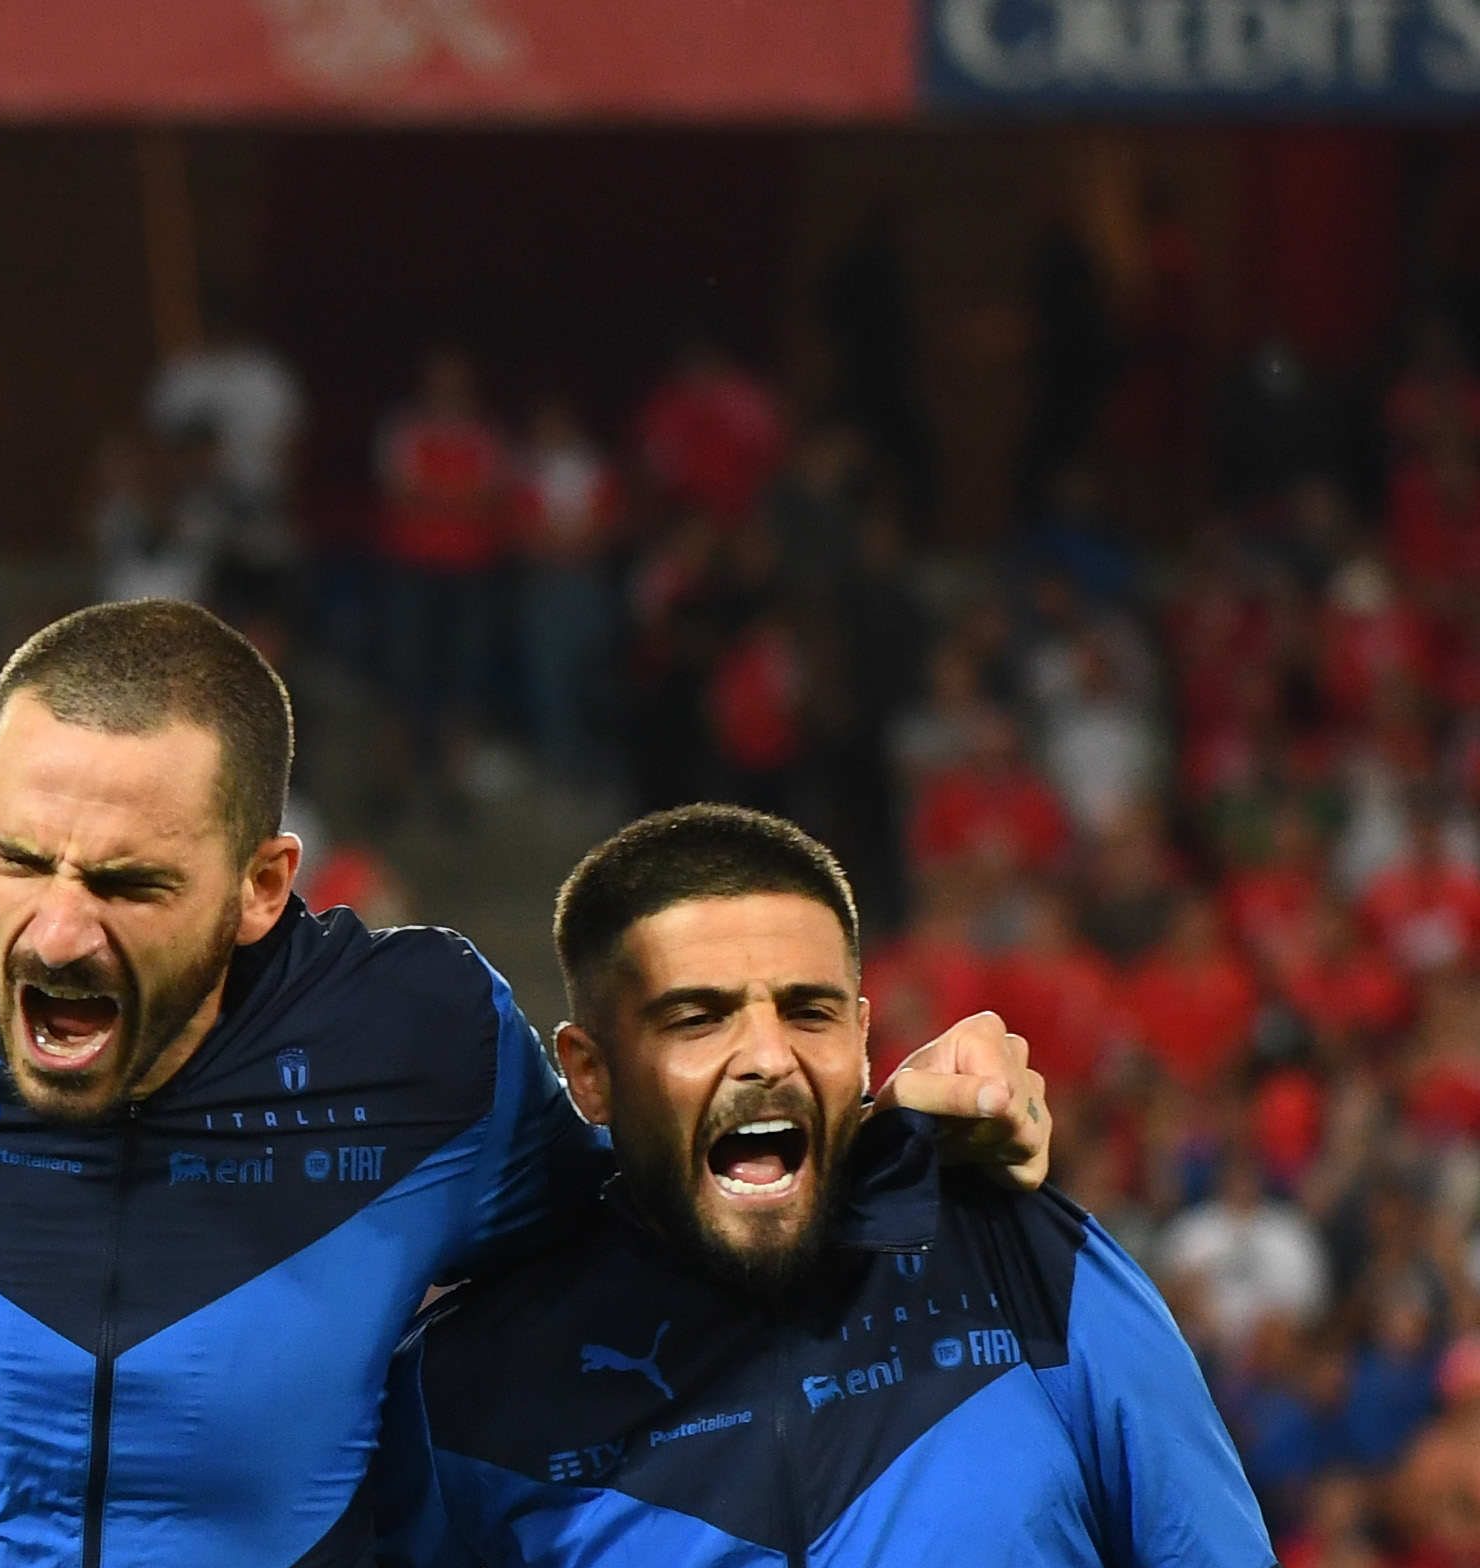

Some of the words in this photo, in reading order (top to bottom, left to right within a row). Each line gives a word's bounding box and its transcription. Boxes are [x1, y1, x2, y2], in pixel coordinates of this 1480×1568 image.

[204, 1106, 368, 1131] ITALIA
[215, 1146, 275, 1184] eni
[338, 1146, 387, 1182] FIAT
[845, 1345, 905, 1395] eni
